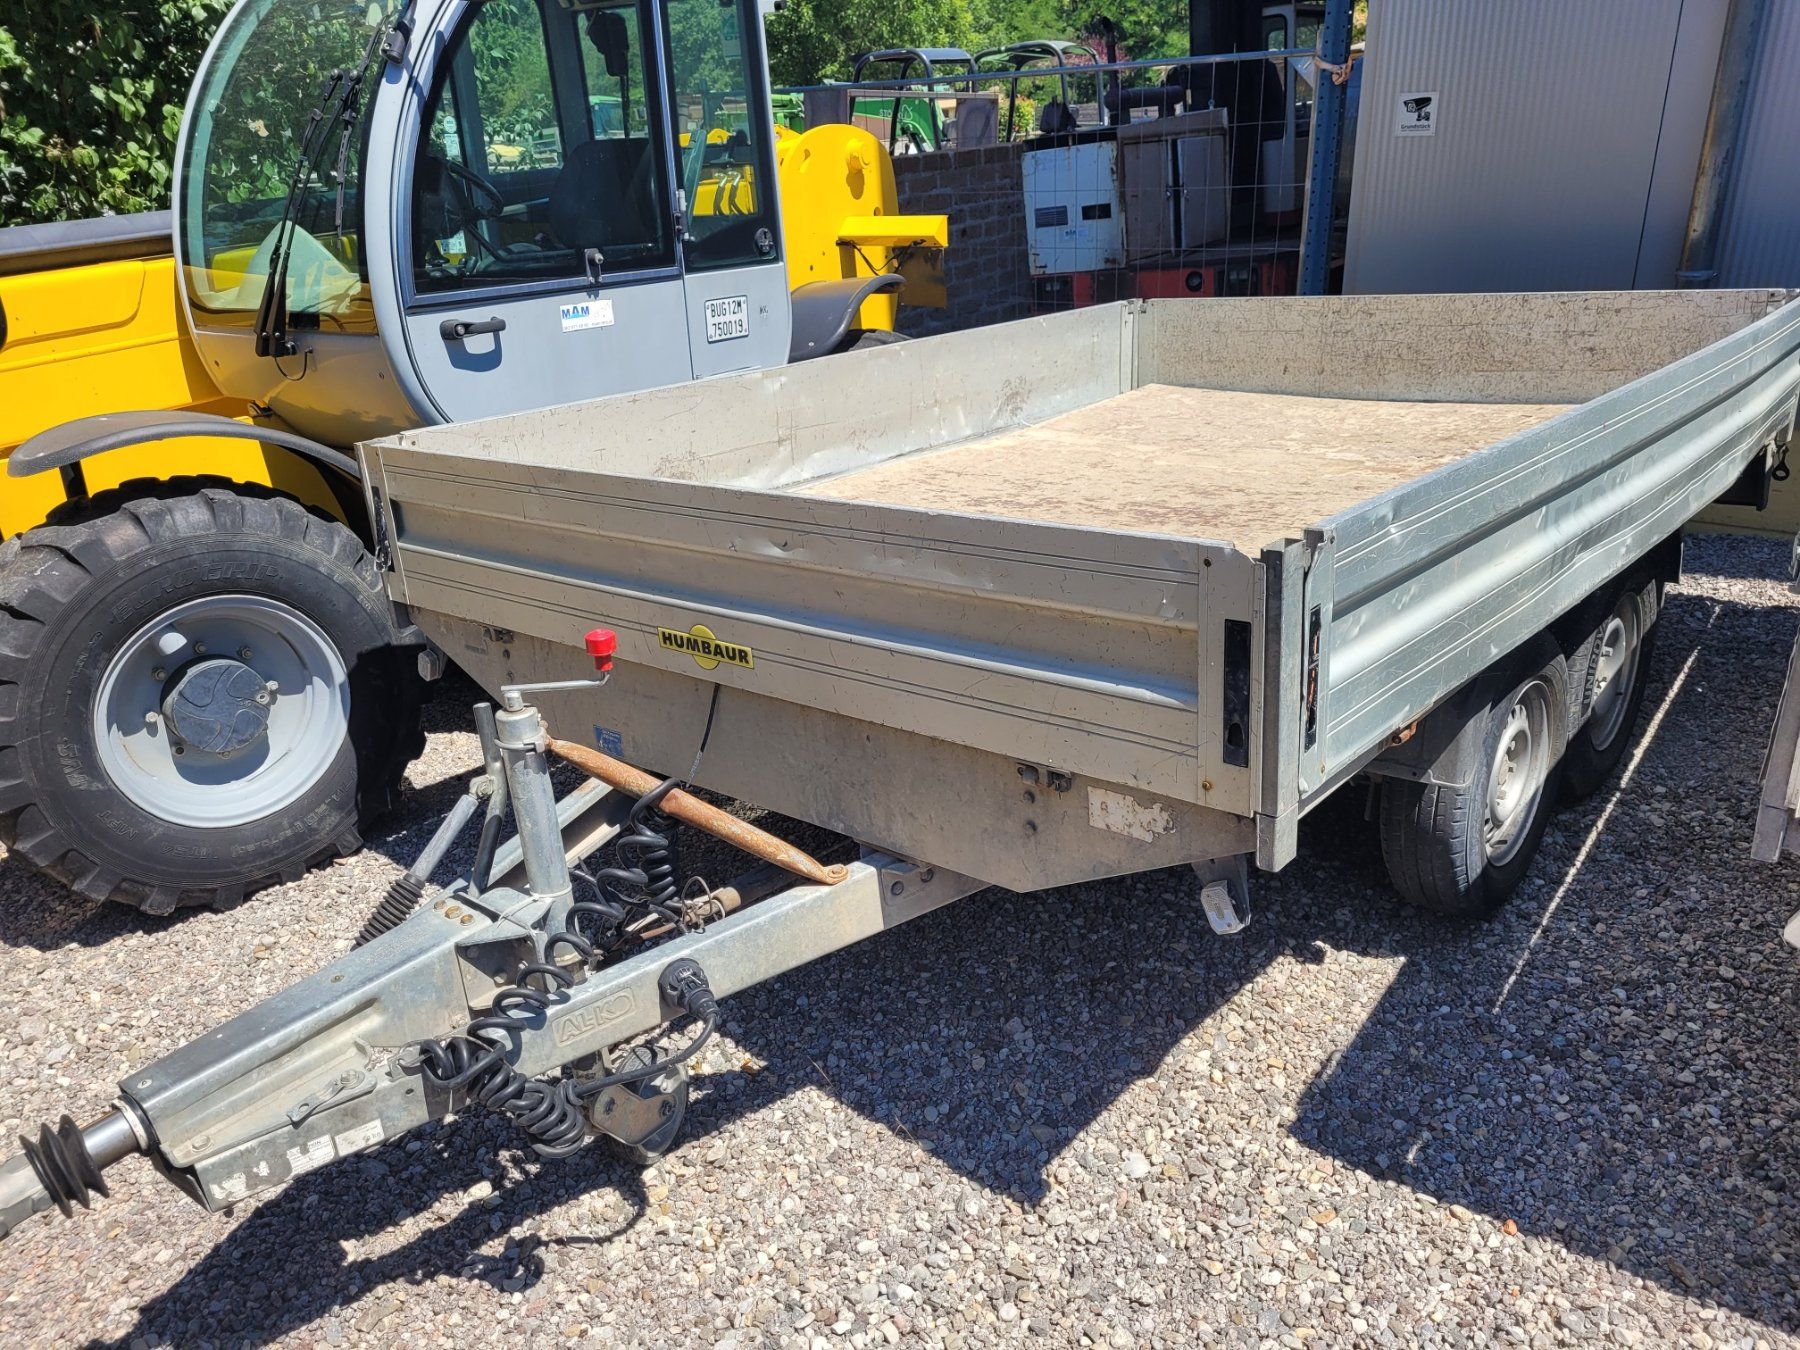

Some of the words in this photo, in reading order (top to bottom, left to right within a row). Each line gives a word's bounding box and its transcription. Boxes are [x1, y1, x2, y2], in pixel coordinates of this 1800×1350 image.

[711, 299, 743, 318] BUG12M
[712, 319, 743, 338] 750019
[661, 630, 750, 665] HUMBAUR
